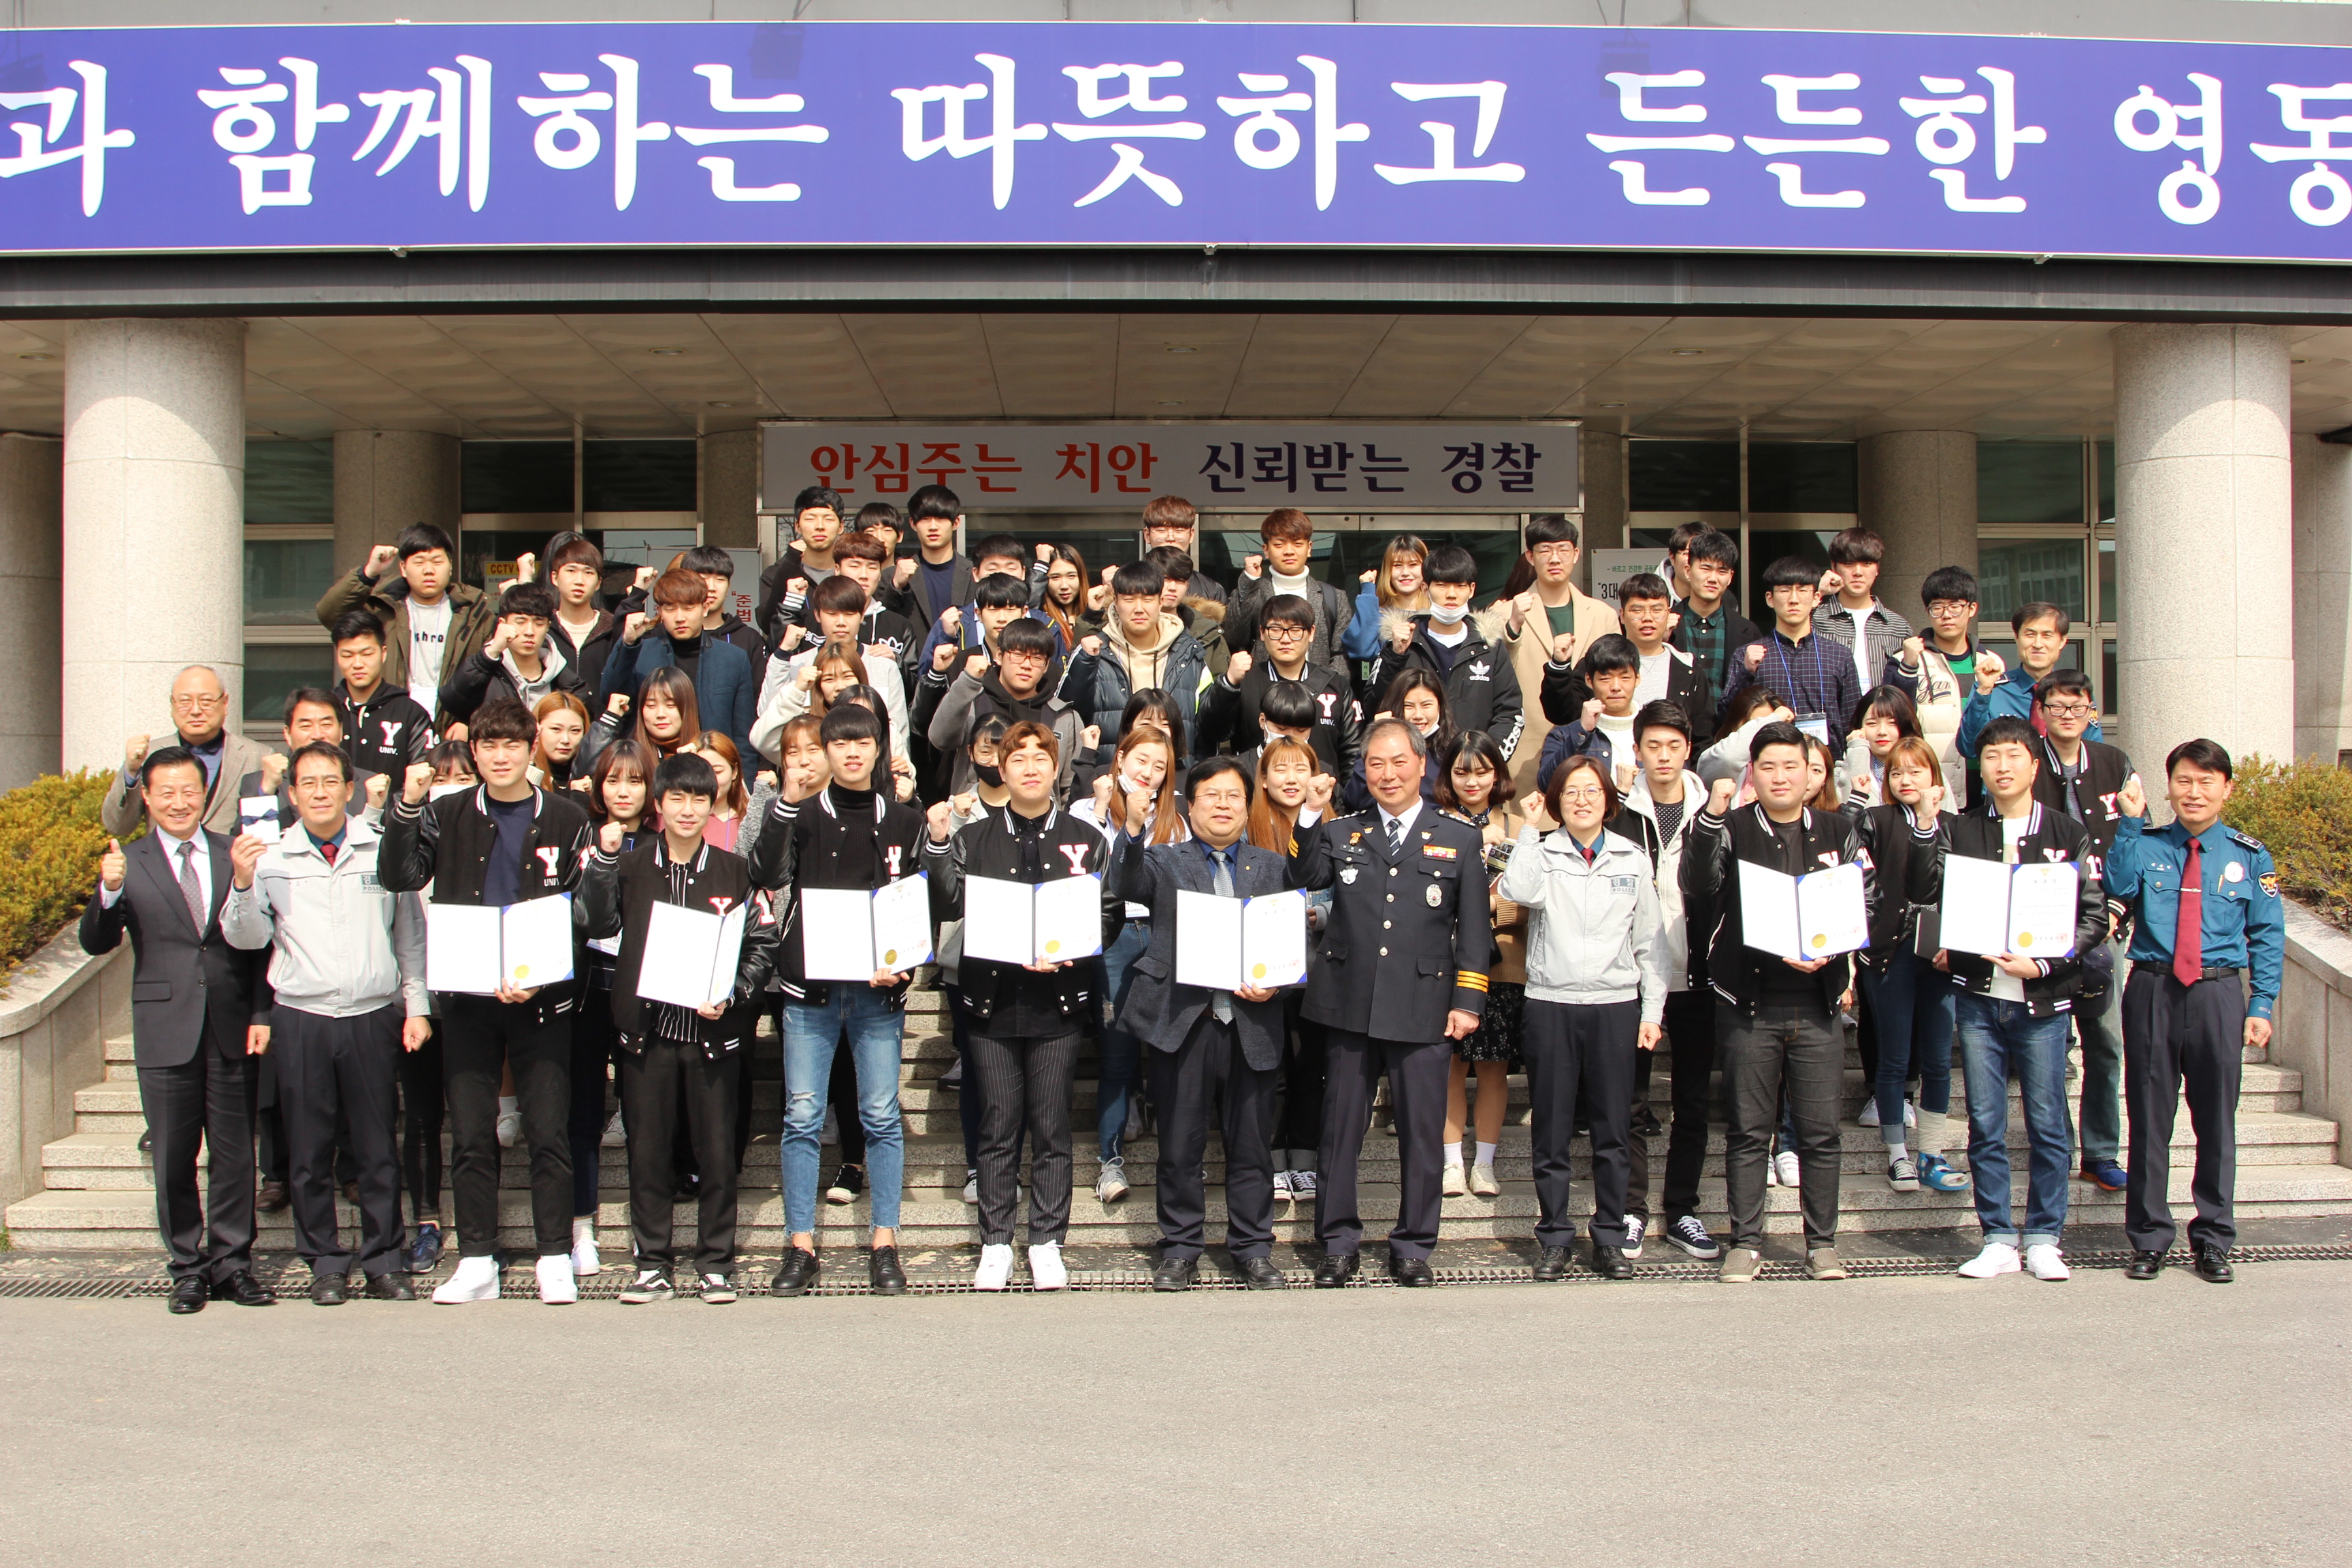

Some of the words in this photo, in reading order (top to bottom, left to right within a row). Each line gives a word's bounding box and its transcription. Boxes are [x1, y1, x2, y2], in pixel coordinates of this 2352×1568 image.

[197, 54, 829, 215] 함께하는
[890, 53, 1526, 213] 따뜻하고
[1586, 67, 2047, 214] 든든한
[2114, 73, 2352, 226] 영동
[811, 442, 1023, 494] 안심주는
[1056, 442, 1158, 493] 치안
[1198, 441, 1409, 493] 신뢰받는
[1441, 442, 1542, 494] 경찰
[491, 564, 514, 574] CCTV
[1316, 693, 1338, 718] Y
[380, 721, 403, 747] Y
[378, 746, 398, 755] UNIV.
[2099, 791, 2118, 814] Y
[536, 846, 560, 877] Y
[887, 845, 902, 875] Y
[1058, 843, 1090, 876] Y
[1612, 878, 1634, 887] 경찰
[708, 896, 734, 917] Y
